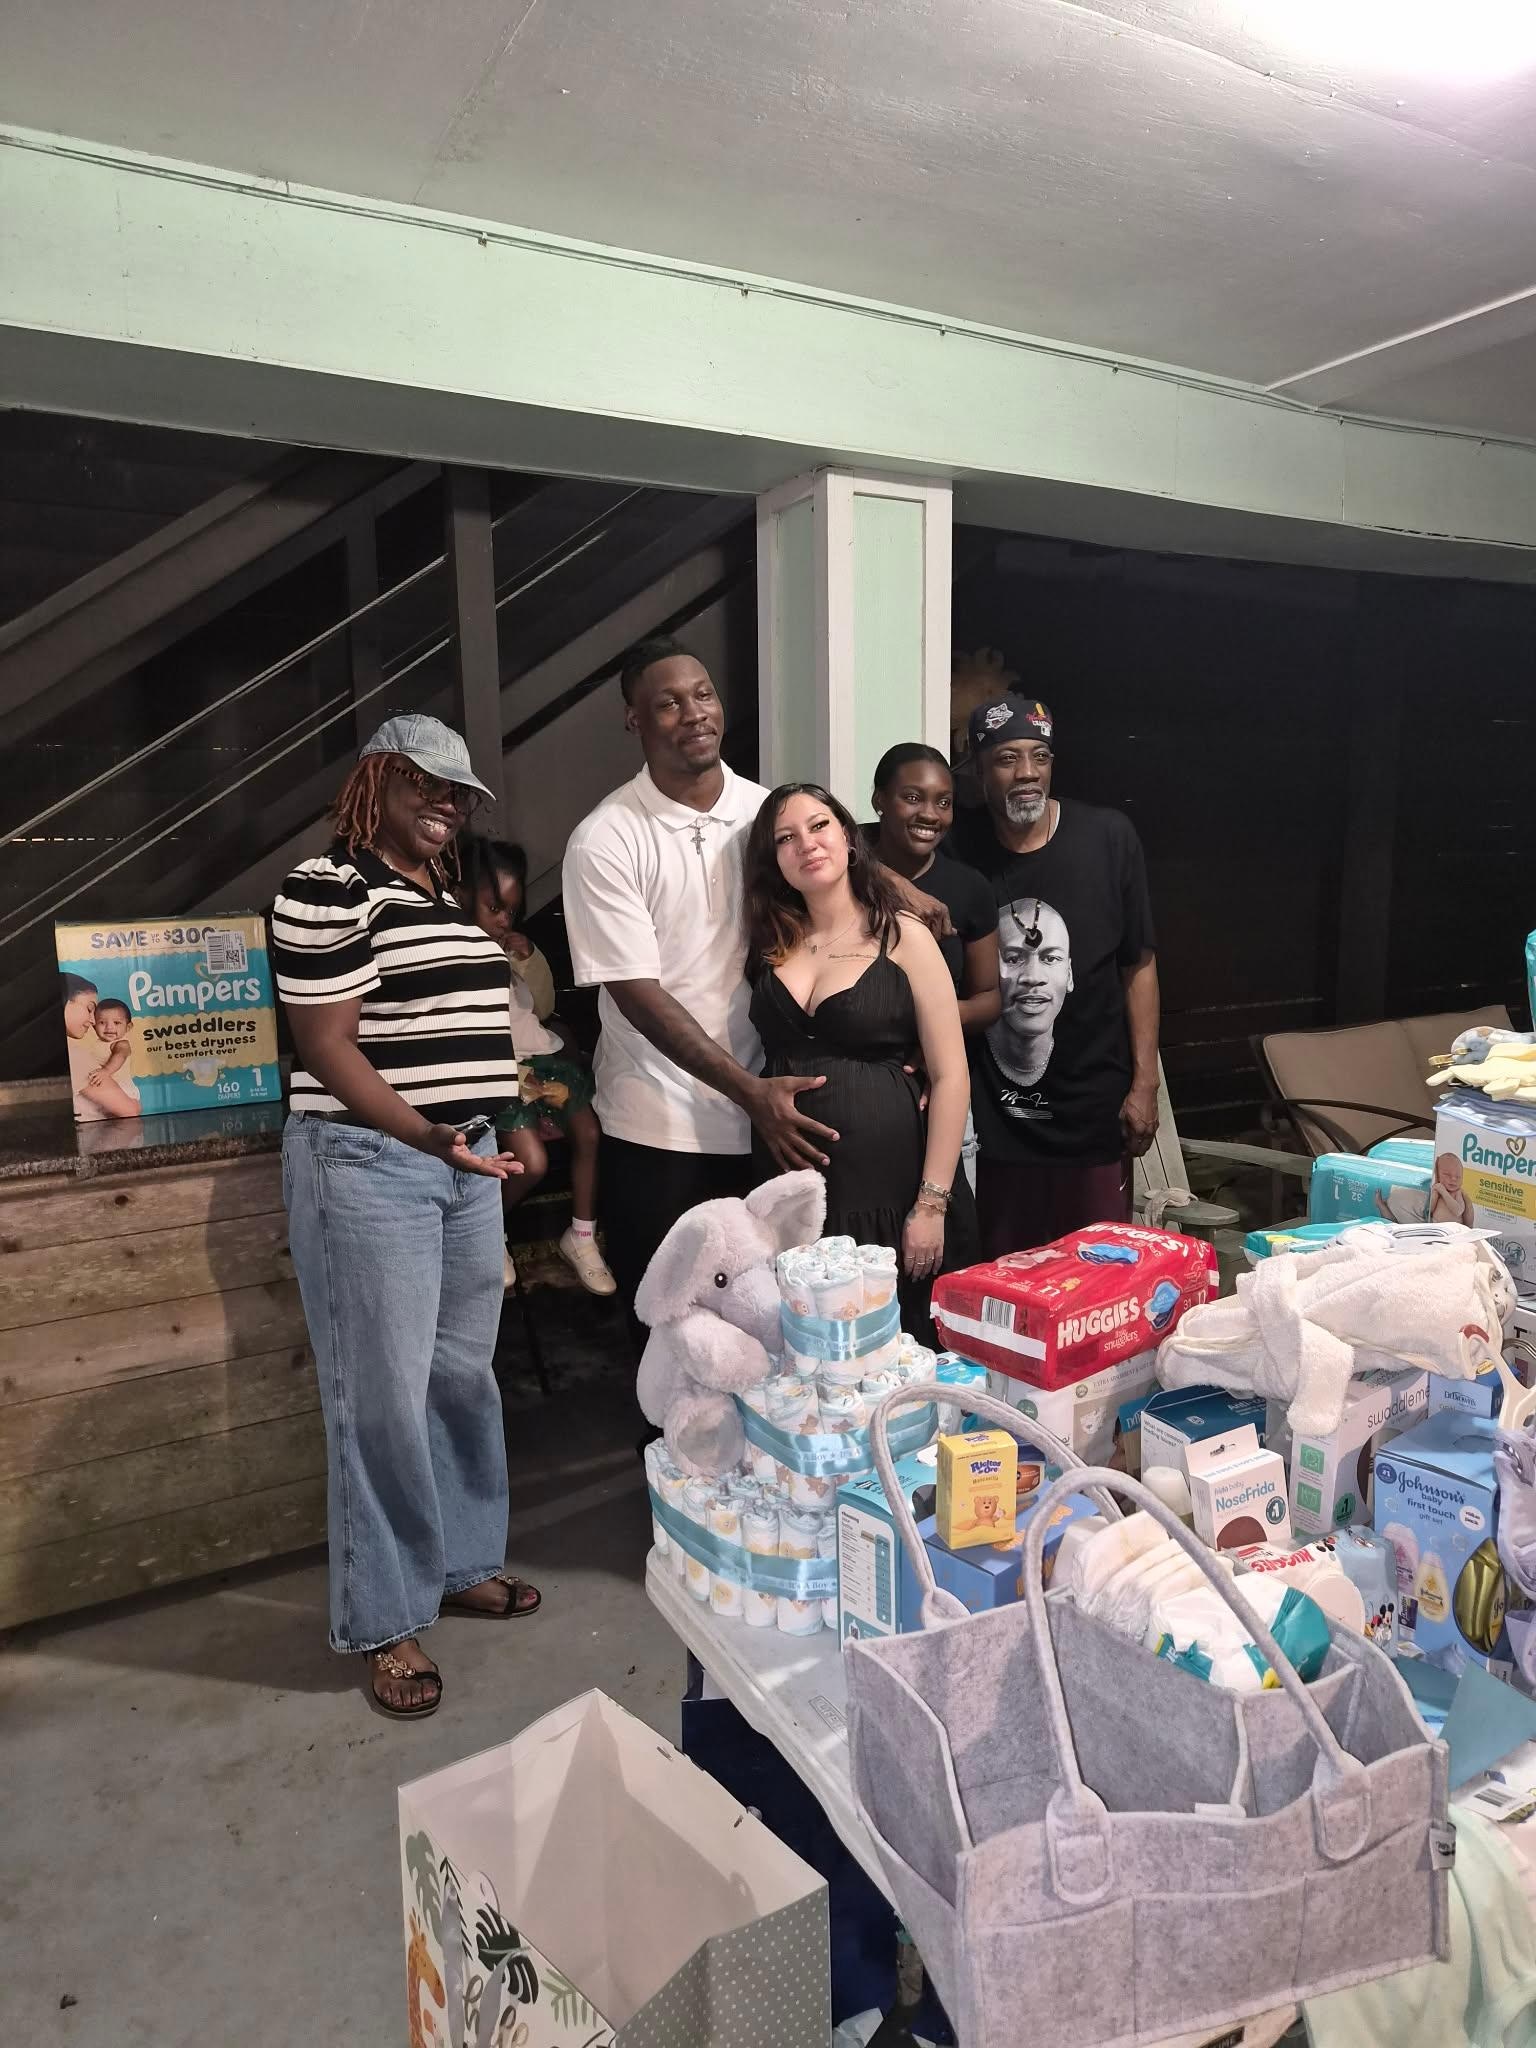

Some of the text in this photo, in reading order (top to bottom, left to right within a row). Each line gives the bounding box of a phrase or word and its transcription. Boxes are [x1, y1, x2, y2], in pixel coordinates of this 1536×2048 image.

[91, 930, 148, 949] SAVE
[128, 971, 261, 1011] Pampers
[143, 1017, 256, 1041] swaddlers
[146, 1035, 256, 1054] our best dryness
[174, 1048, 212, 1060] comfort
[215, 1047, 238, 1056] ever
[217, 1081, 240, 1094] 160
[252, 1067, 262, 1087] 1
[1462, 1133, 1536, 1177] Pamper
[1479, 1178, 1524, 1197] sensitive
[1057, 1297, 1141, 1350] HUGGIES
[1216, 1481, 1275, 1513] NoseFrida
[1397, 1471, 1465, 1505] Johnson's
[1421, 1492, 1443, 1506] baby
[1407, 1498, 1456, 1521] first touch
[1250, 1548, 1316, 1573] HUGGIES
